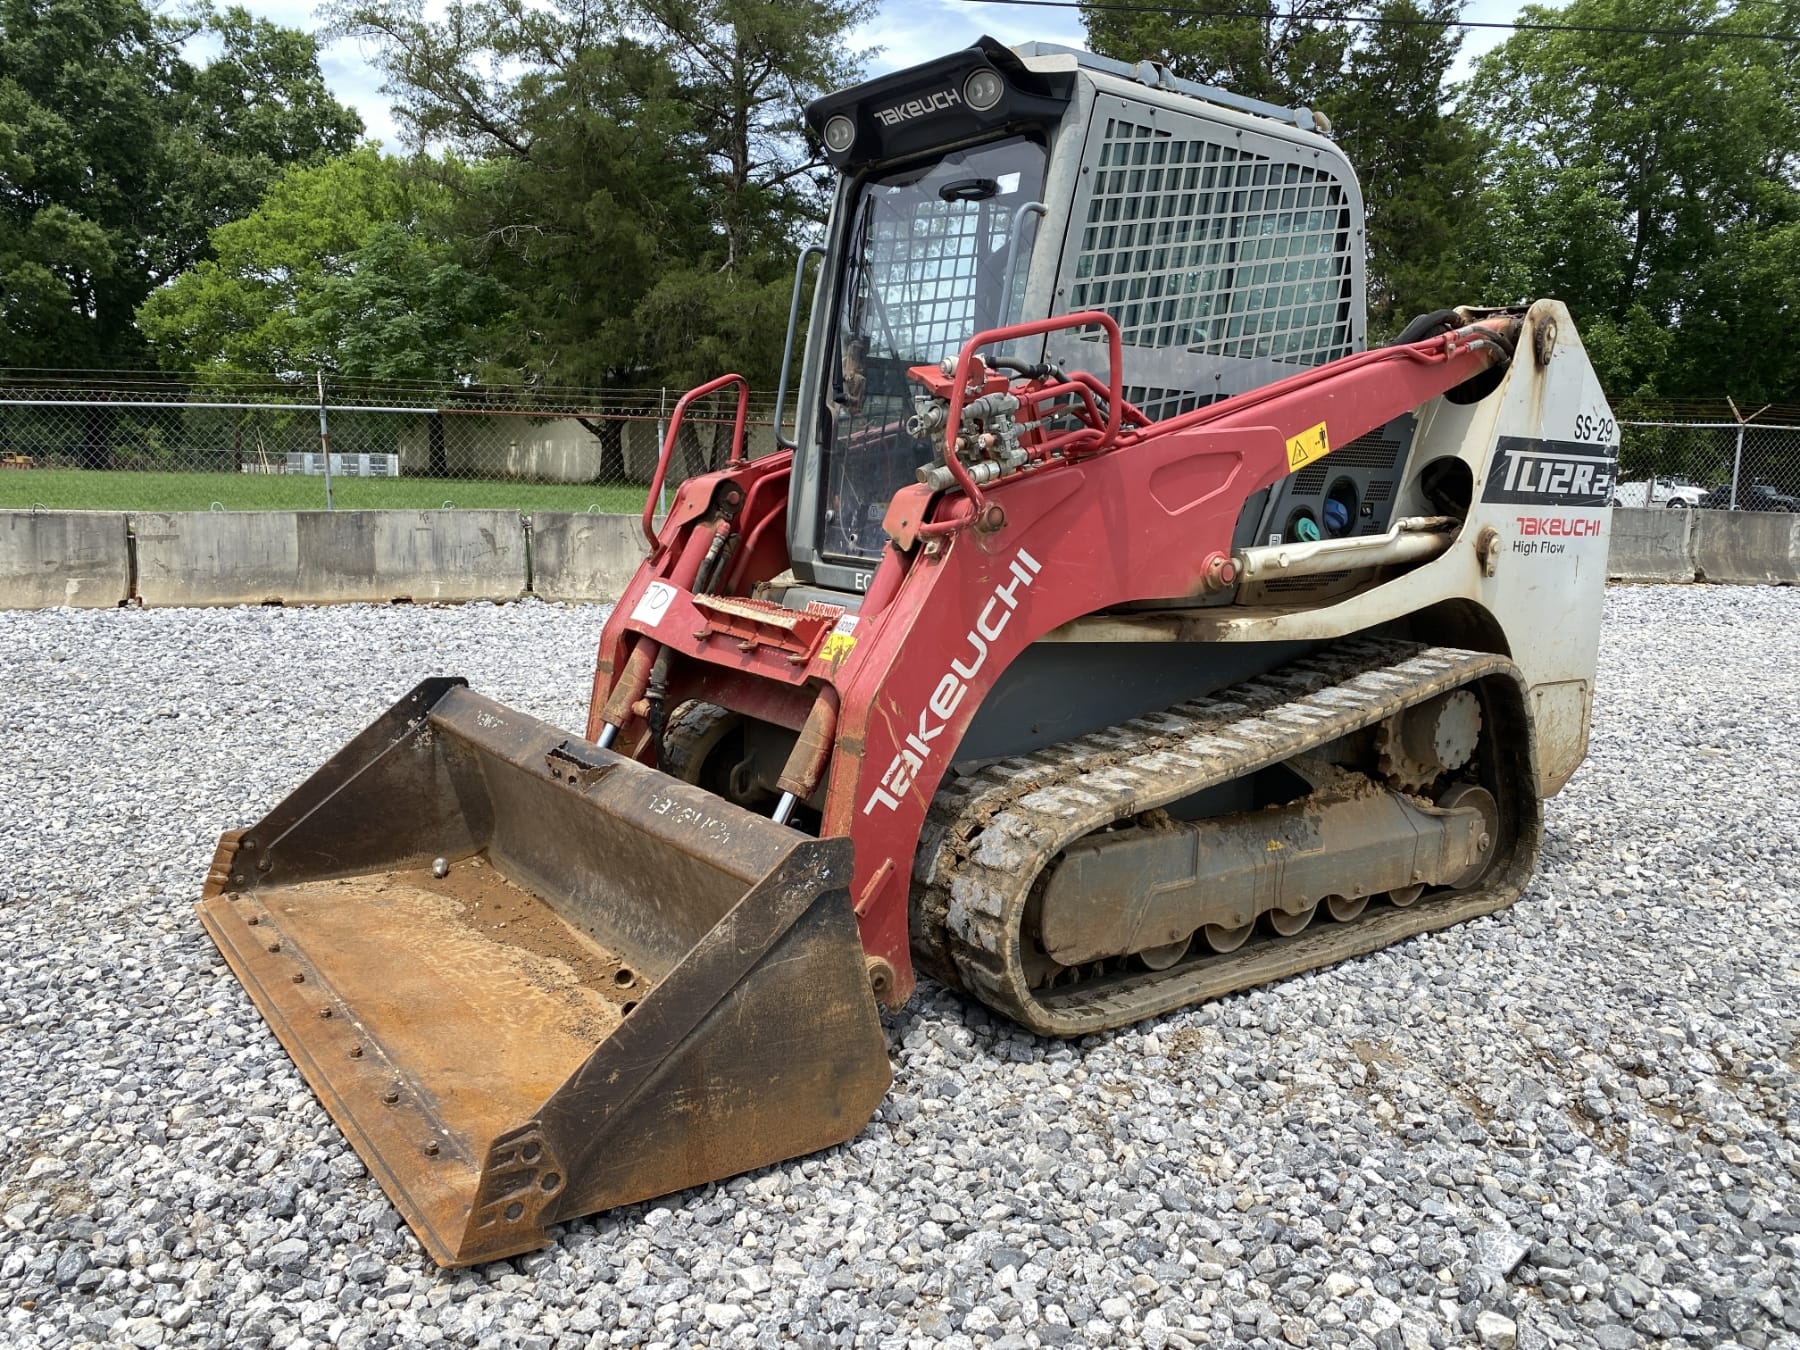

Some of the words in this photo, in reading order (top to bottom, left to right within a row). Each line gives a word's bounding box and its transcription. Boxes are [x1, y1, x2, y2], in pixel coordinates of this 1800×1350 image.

[1574, 414, 1613, 442] SS-29
[1516, 517, 1601, 537] TAKEUCHI
[1512, 541, 1537, 556] High
[1540, 541, 1565, 554] Flow
[808, 602, 845, 619] WARNING
[862, 547, 1042, 816] TAKEUCHI
